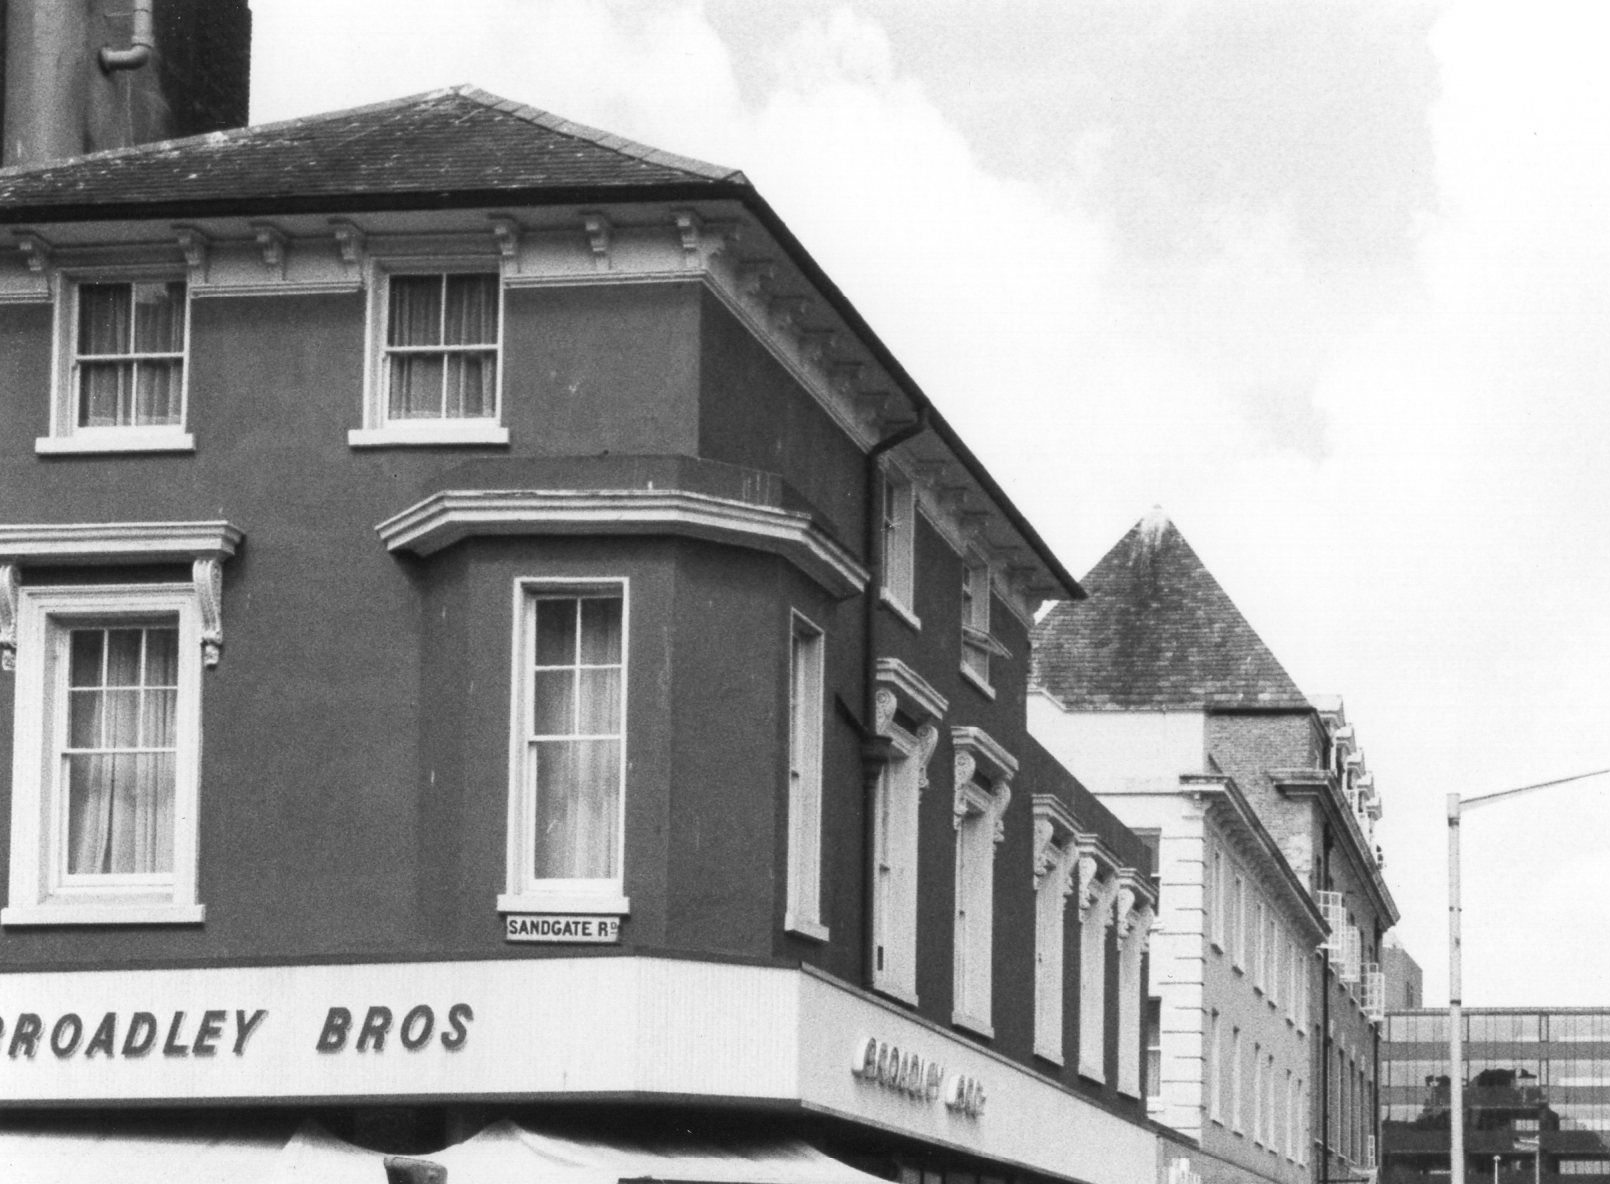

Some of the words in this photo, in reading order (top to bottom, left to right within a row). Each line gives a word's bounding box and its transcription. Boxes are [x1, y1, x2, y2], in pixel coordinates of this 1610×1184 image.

[508, 919, 592, 937] SANDGATE
[0, 1009, 268, 1058] ROADLEY
[315, 1003, 474, 1054] BROS
